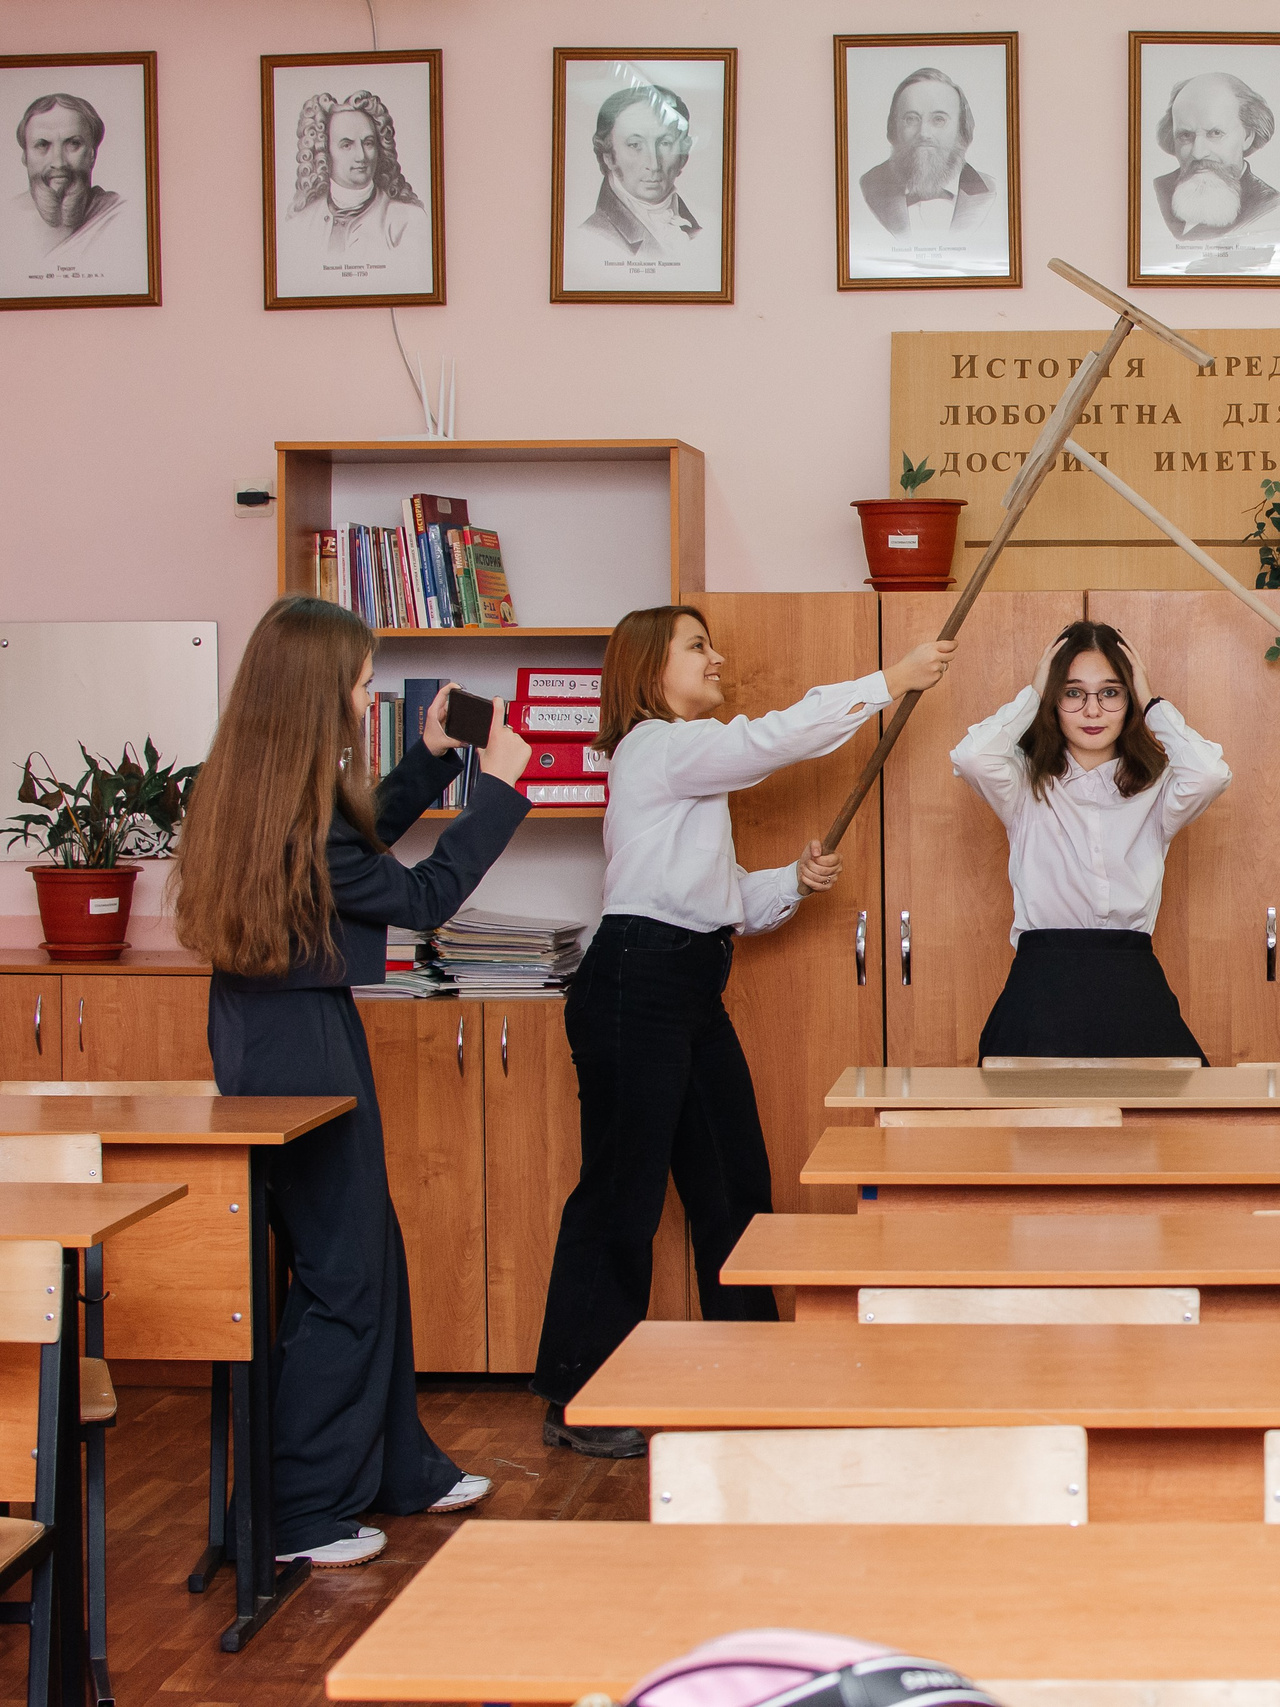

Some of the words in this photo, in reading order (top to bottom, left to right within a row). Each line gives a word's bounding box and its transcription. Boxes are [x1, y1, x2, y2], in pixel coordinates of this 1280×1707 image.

[951, 354, 1145, 379] ИСТОРЯ
[940, 403, 1182, 425] ЛЮБОЫТНА
[940, 451, 1109, 477] ДОСТИН
[1154, 451, 1277, 472] ИМЕТЬ
[413, 498, 424, 532] ИСТОРИЯ
[532, 679, 564, 687] класс
[568, 680, 576, 690] 6
[591, 680, 599, 690] 5
[538, 713, 570, 721] класс
[574, 714, 595, 725] 7-8
